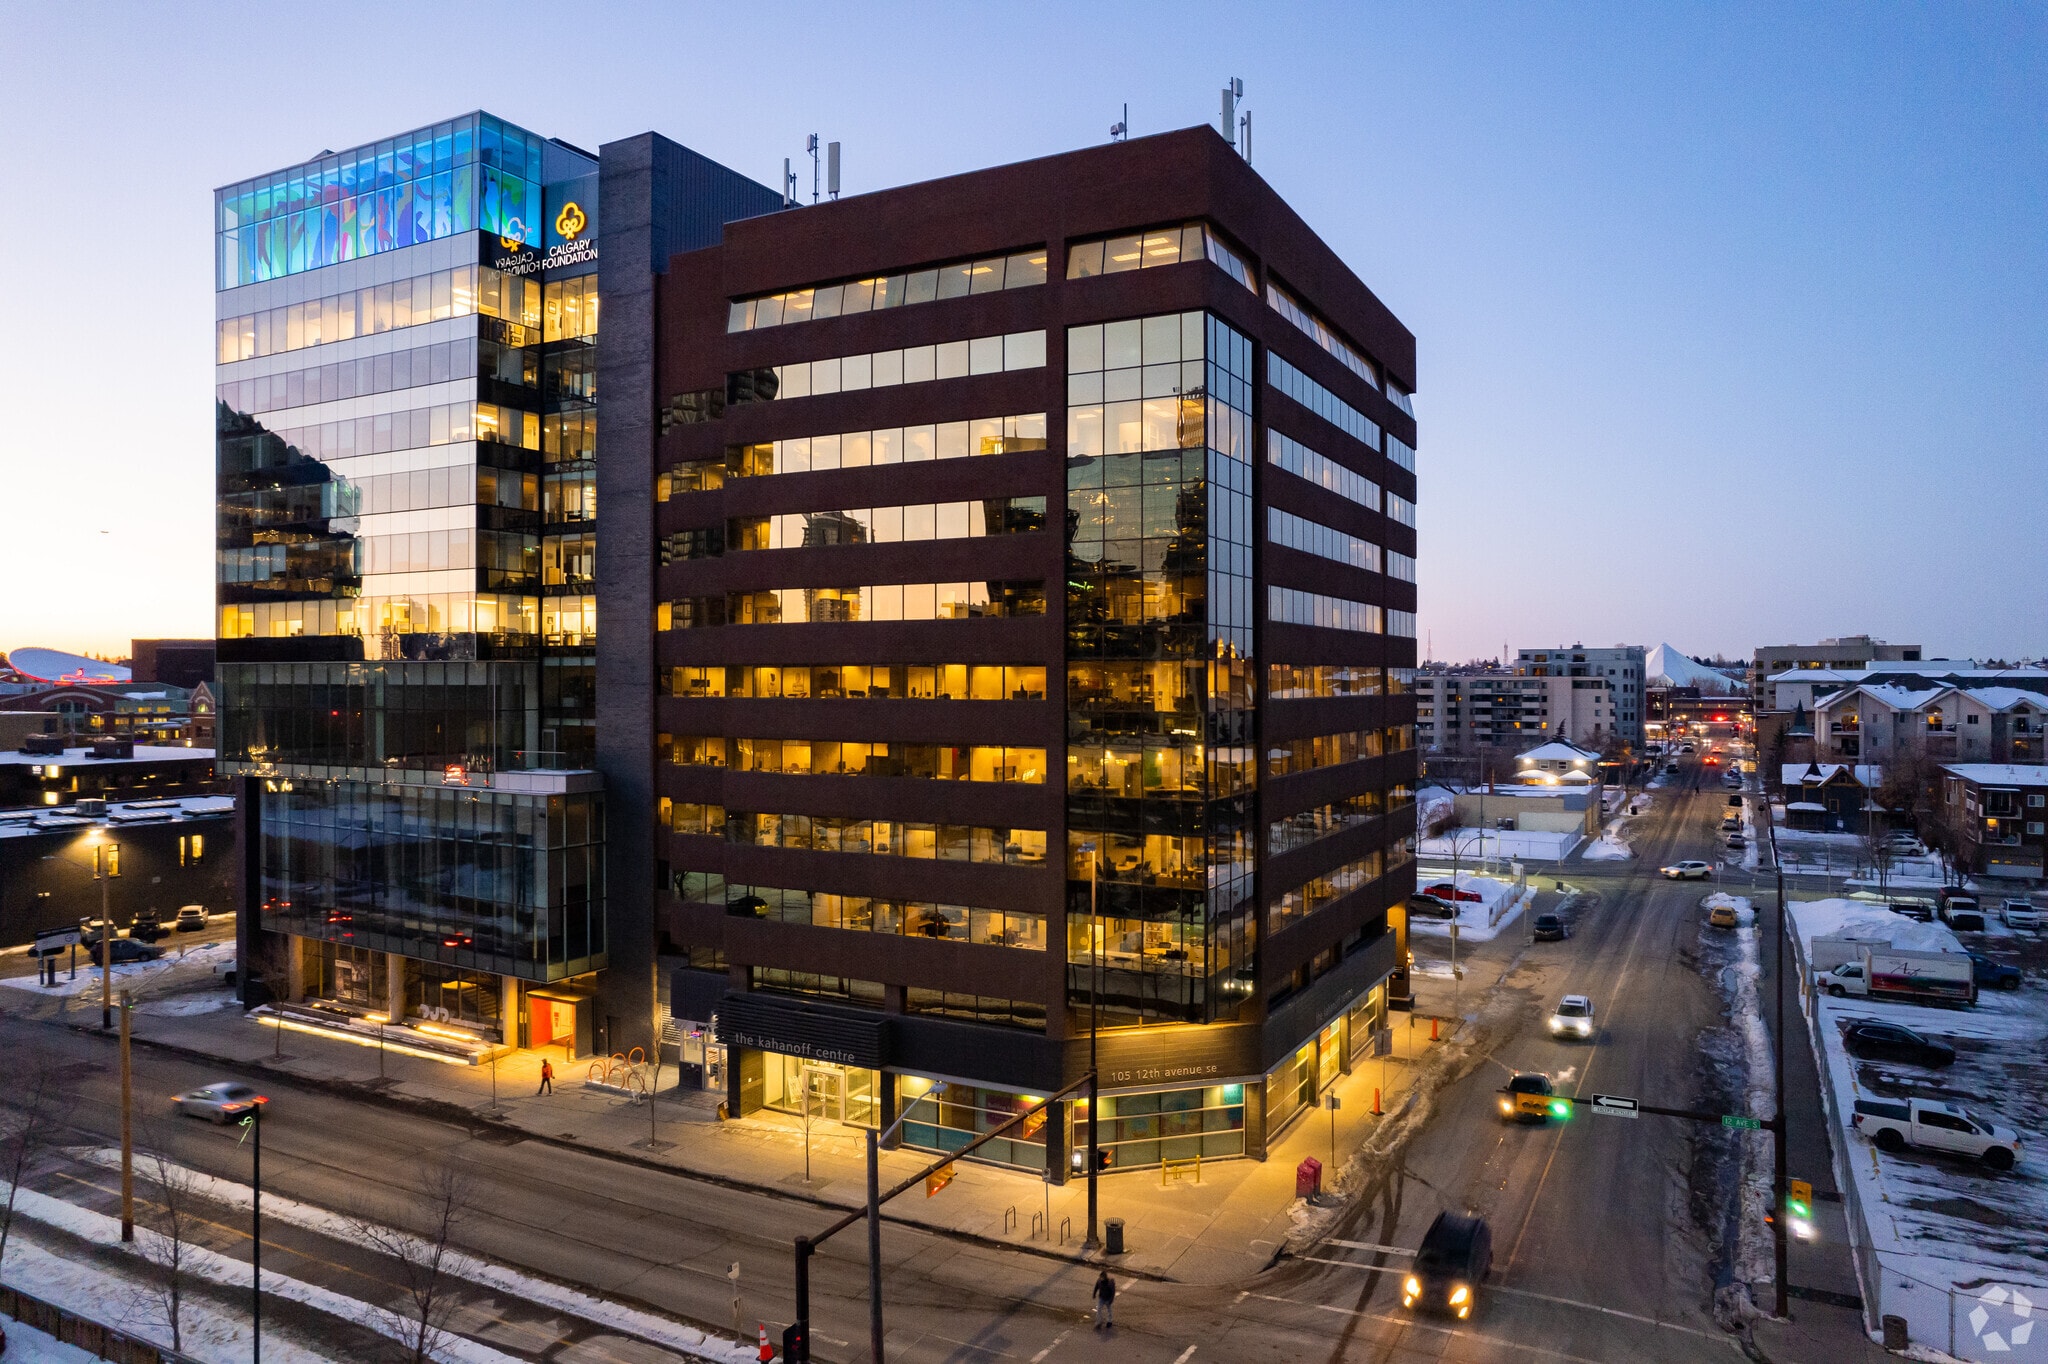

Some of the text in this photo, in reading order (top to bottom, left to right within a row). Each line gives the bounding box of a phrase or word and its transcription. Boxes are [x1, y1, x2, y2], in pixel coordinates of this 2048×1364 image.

[549, 238, 591, 257] CALGARY
[542, 248, 598, 270] FOUNDATION
[735, 1032, 855, 1063] the kahanoff centre
[1111, 1064, 1218, 1082] 105 12th avenue se
[1725, 1117, 1733, 1125] 12
